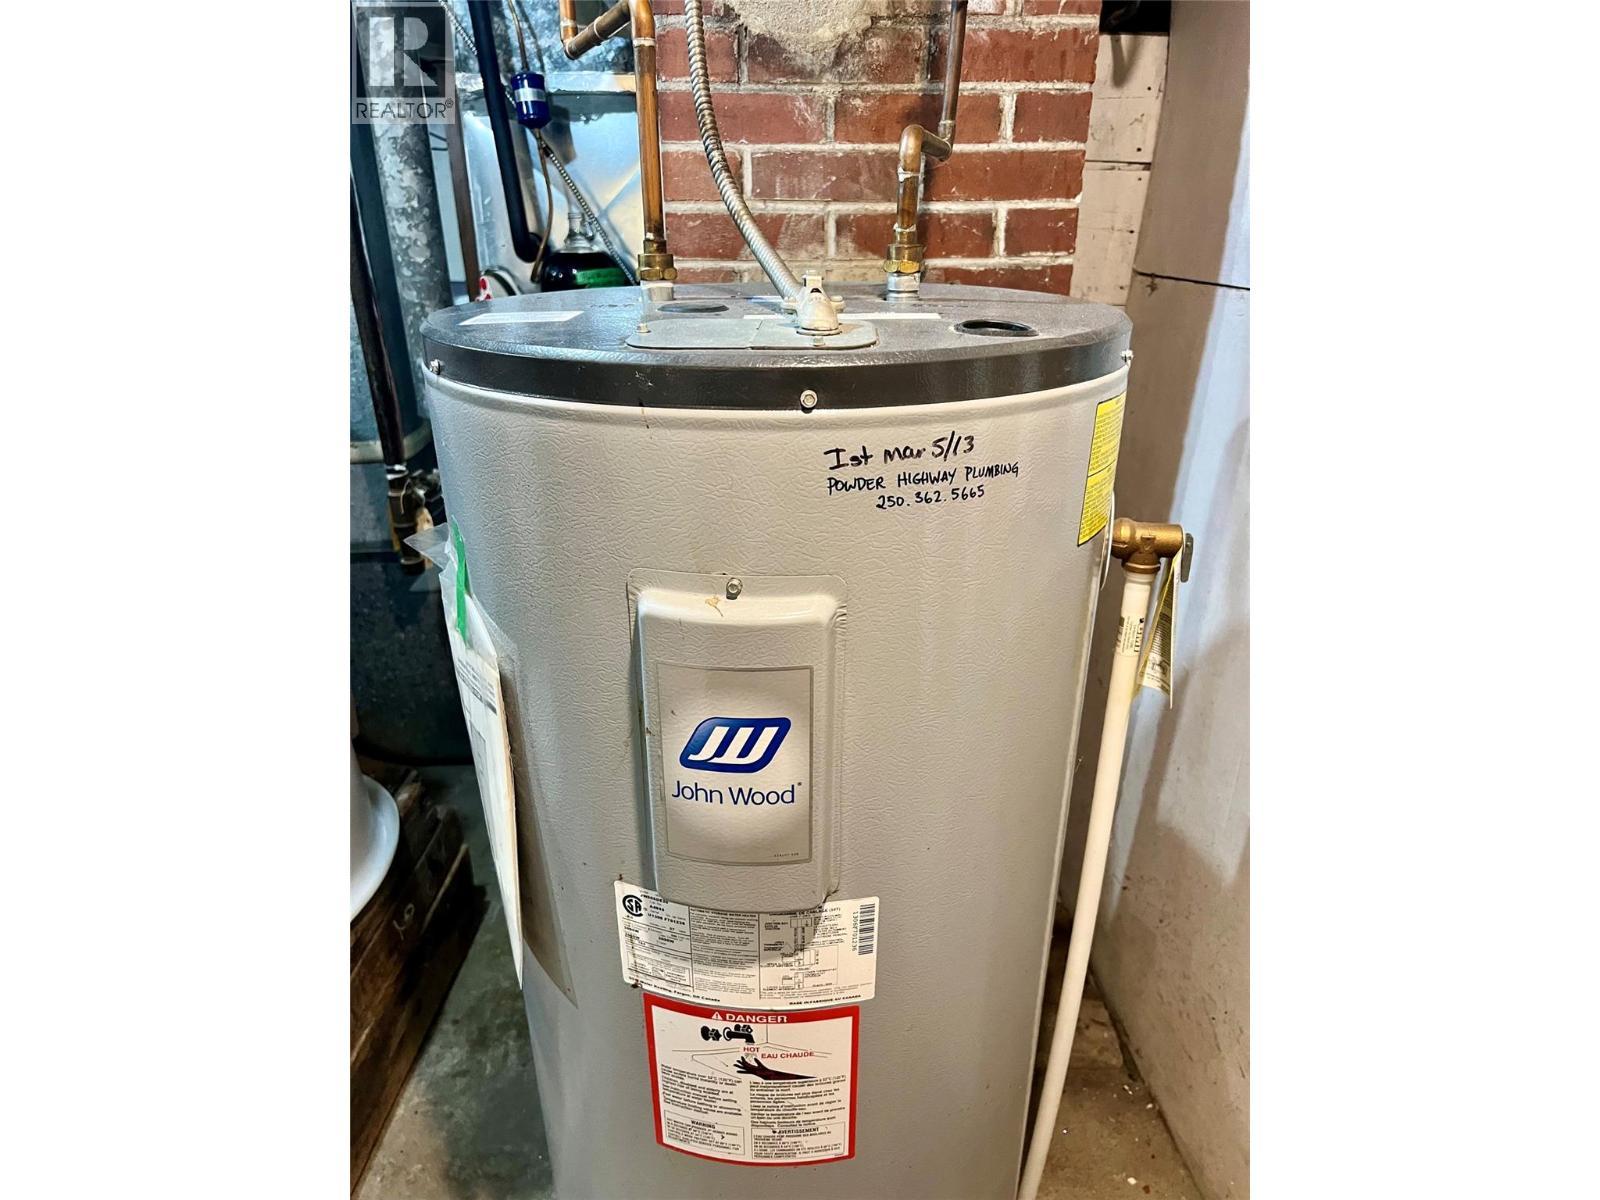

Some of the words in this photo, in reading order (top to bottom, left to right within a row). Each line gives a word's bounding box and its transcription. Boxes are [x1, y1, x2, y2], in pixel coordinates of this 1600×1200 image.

[932, 430, 975, 462] 5/13
[827, 476, 886, 495] POWDER
[898, 468, 957, 488] HIGHWAY
[964, 462, 1019, 481] PLUMBING
[672, 780, 723, 804] John
[726, 1013, 788, 1023] DANGER
[691, 1120, 716, 1129] WARNING
